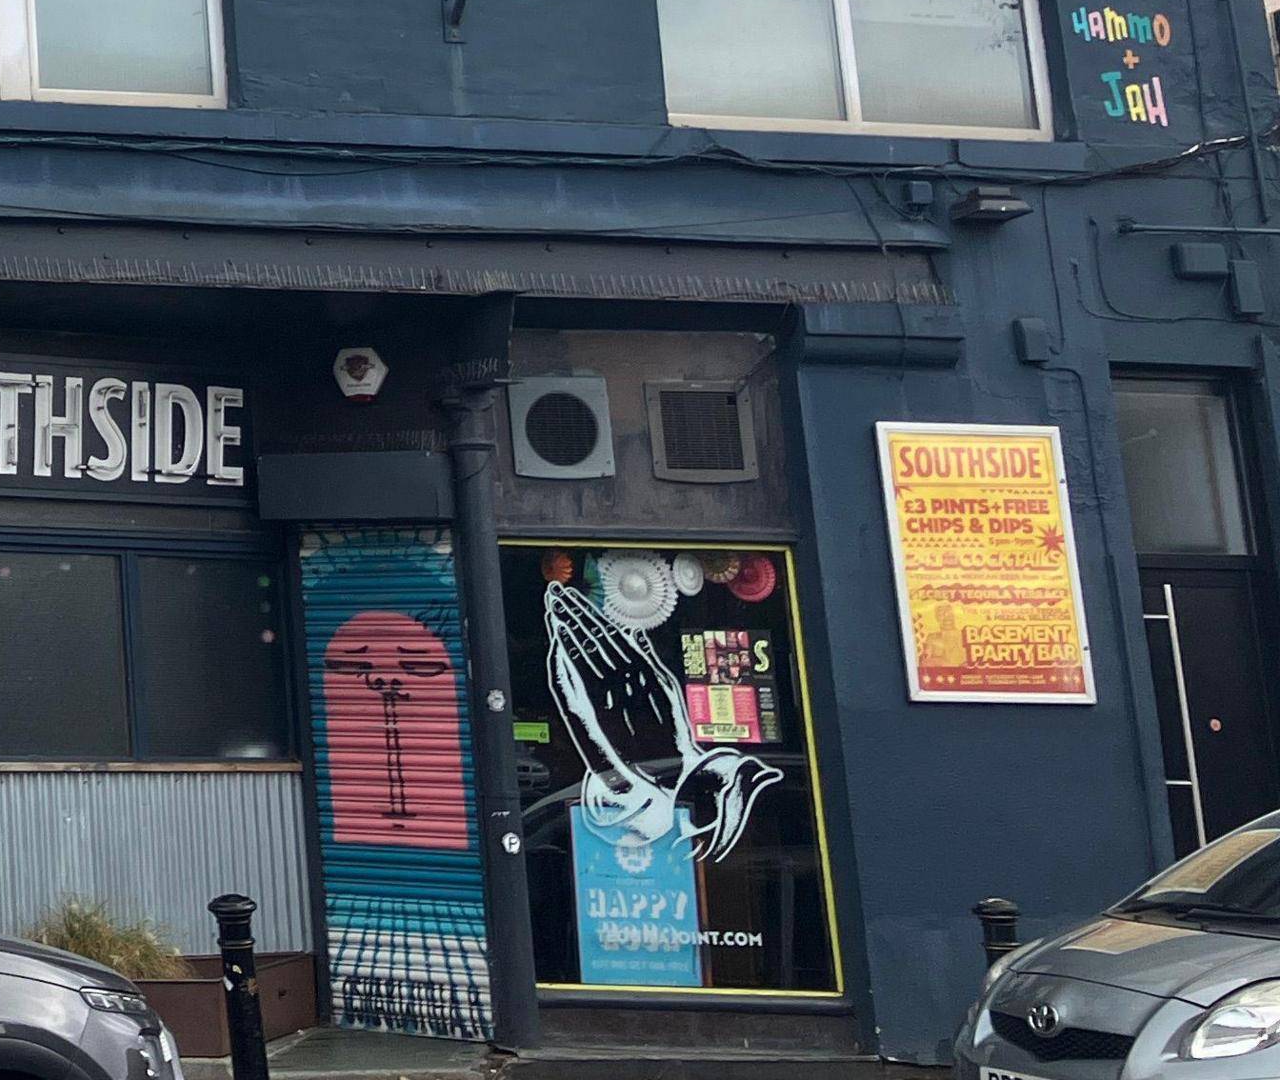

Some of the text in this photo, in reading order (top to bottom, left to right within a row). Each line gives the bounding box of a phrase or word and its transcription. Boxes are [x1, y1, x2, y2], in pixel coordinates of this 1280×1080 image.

[1101, 71, 1168, 127] JAH
[899, 446, 1042, 479] SOUTHSIDE
[904, 498, 928, 514] £3
[906, 517, 1033, 534] CHIPS & DIPS
[965, 625, 1072, 643] BASEMENT
[970, 644, 1078, 663] PARTY BAR
[588, 889, 688, 920] HAPPY
